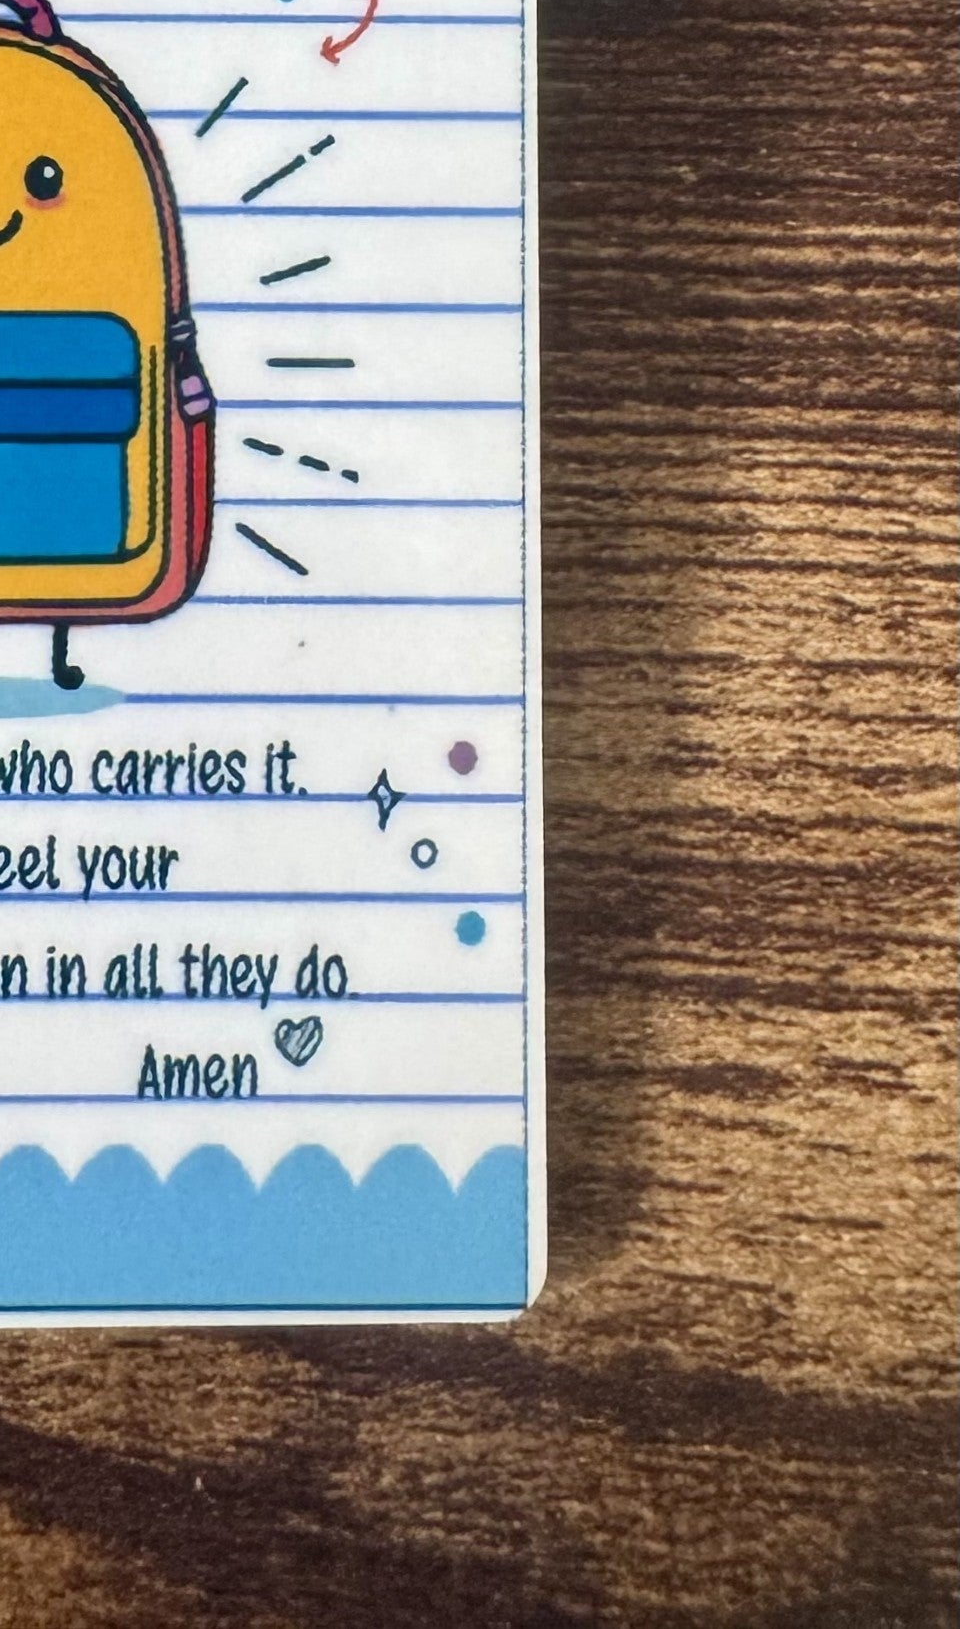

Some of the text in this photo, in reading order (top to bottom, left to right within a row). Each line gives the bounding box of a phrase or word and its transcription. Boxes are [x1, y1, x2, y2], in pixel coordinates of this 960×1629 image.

[91, 742, 247, 795] carries
[264, 742, 308, 796] it.
[78, 845, 179, 900] your
[46, 946, 88, 998] in
[104, 943, 164, 998] all
[179, 943, 279, 1009] they
[138, 1045, 259, 1099] Amen
